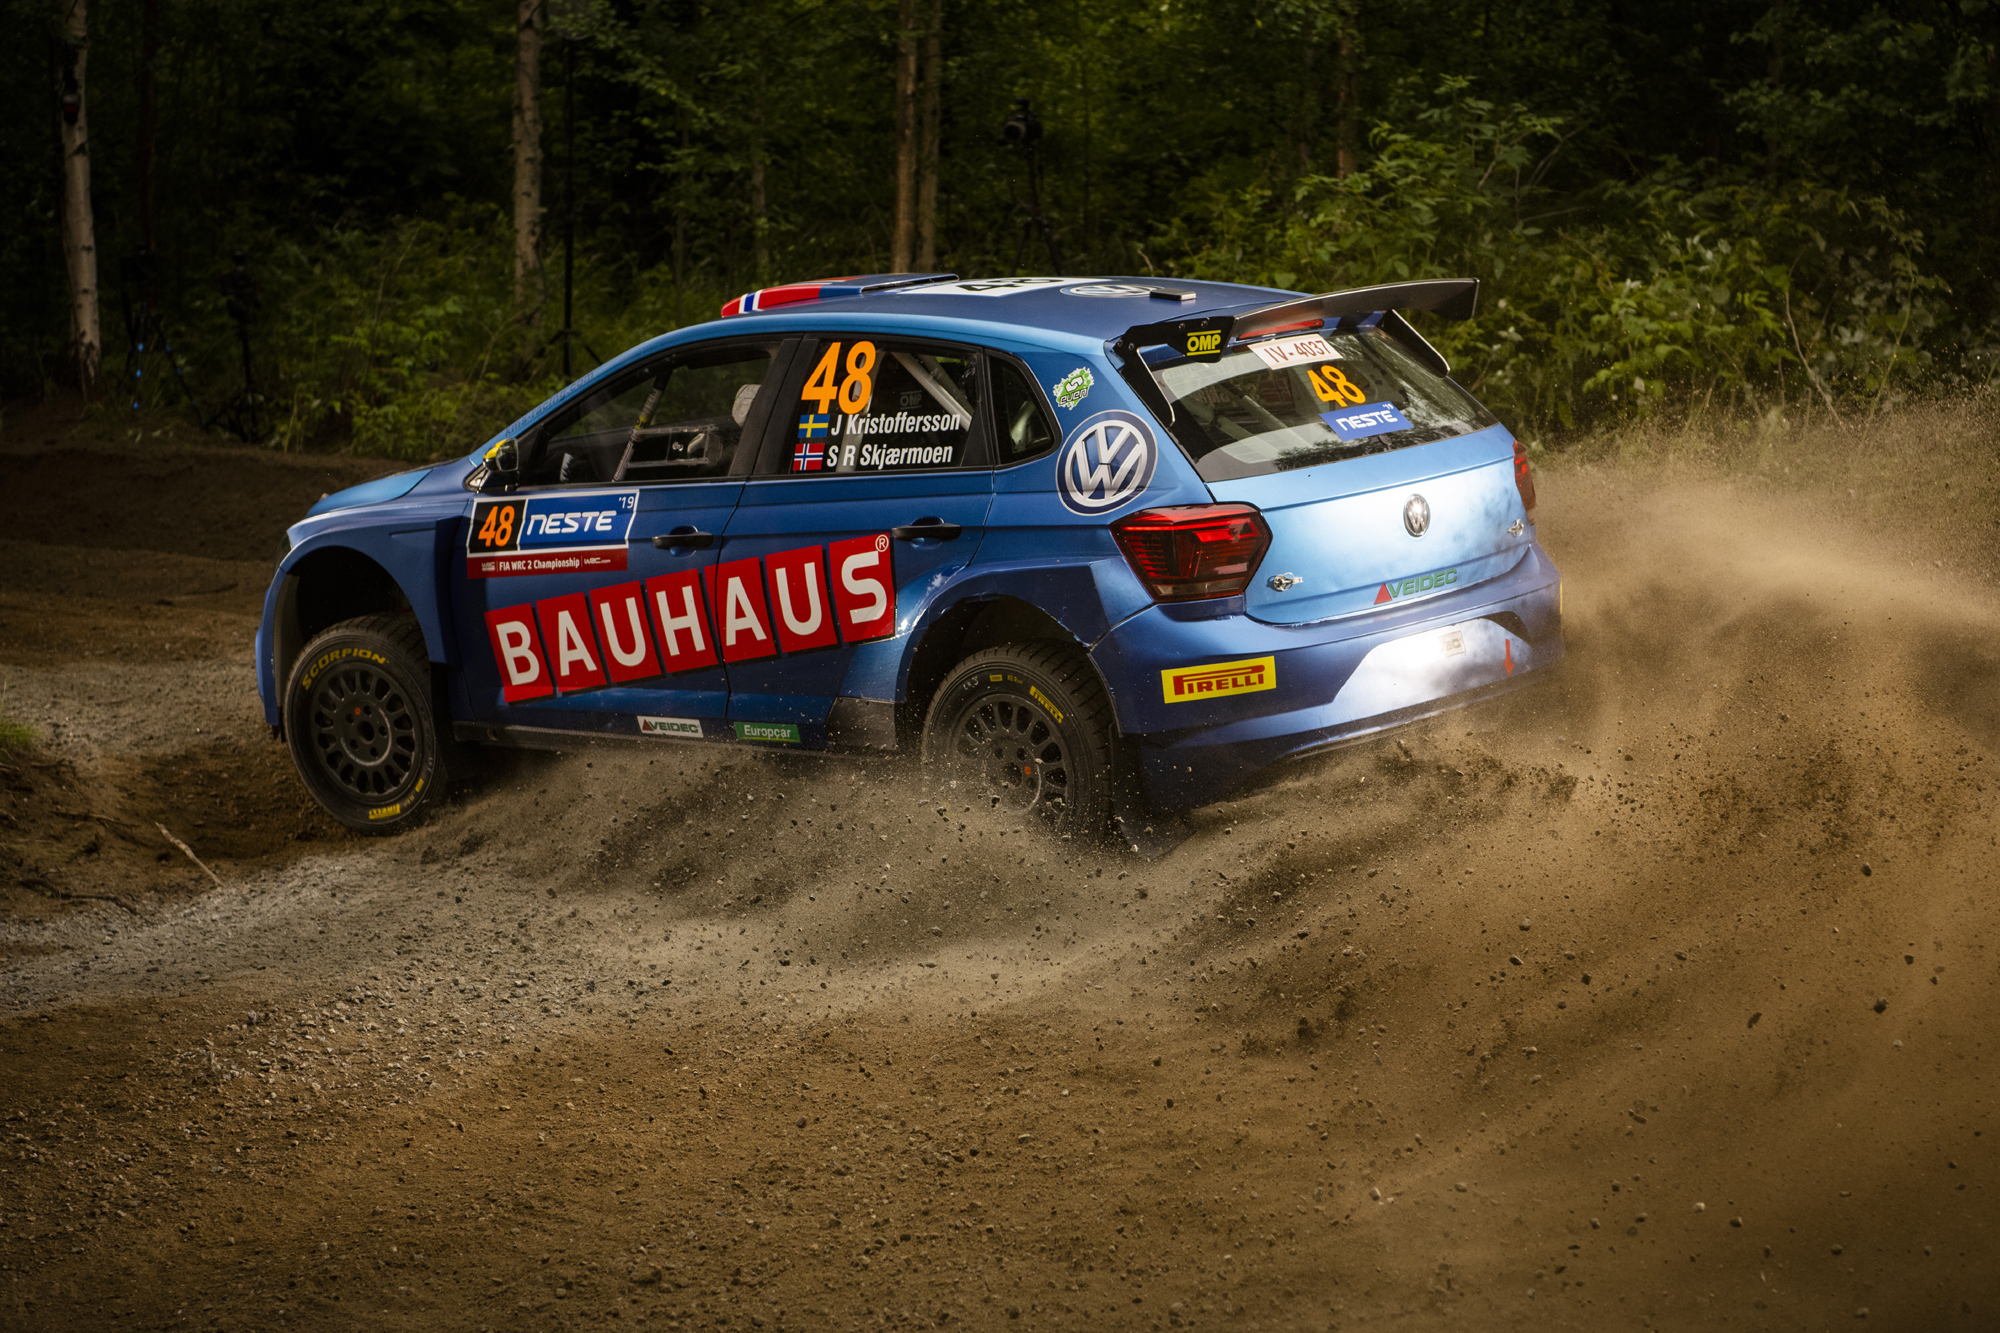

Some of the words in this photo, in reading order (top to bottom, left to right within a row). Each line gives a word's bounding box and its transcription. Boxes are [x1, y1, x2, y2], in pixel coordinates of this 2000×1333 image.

[1187, 334, 1222, 352] OMP
[801, 340, 877, 415] 48
[1307, 365, 1366, 407] 48
[504, 371, 595, 437] kms-racing.com
[830, 414, 843, 436] J
[846, 412, 961, 435] Kristoffersson
[1335, 409, 1399, 432] NESTE
[826, 445, 839, 467] S
[843, 445, 857, 467] R
[860, 444, 954, 471] Skjærmoen
[478, 505, 516, 547] 48
[526, 510, 618, 536] NESTE
[499, 560, 511, 571] FIA
[511, 560, 527, 571] WRC
[527, 560, 533, 570] 2
[533, 557, 580, 570] Championship
[1387, 568, 1458, 598] VEIDEC
[496, 551, 888, 686] BAUHAUS
[302, 648, 387, 691] SCORPION
[1173, 664, 1265, 695] PIRELLI
[1029, 685, 1064, 723] PIRELLI
[648, 721, 699, 734] VEIDEC
[744, 724, 791, 740] Europcar
